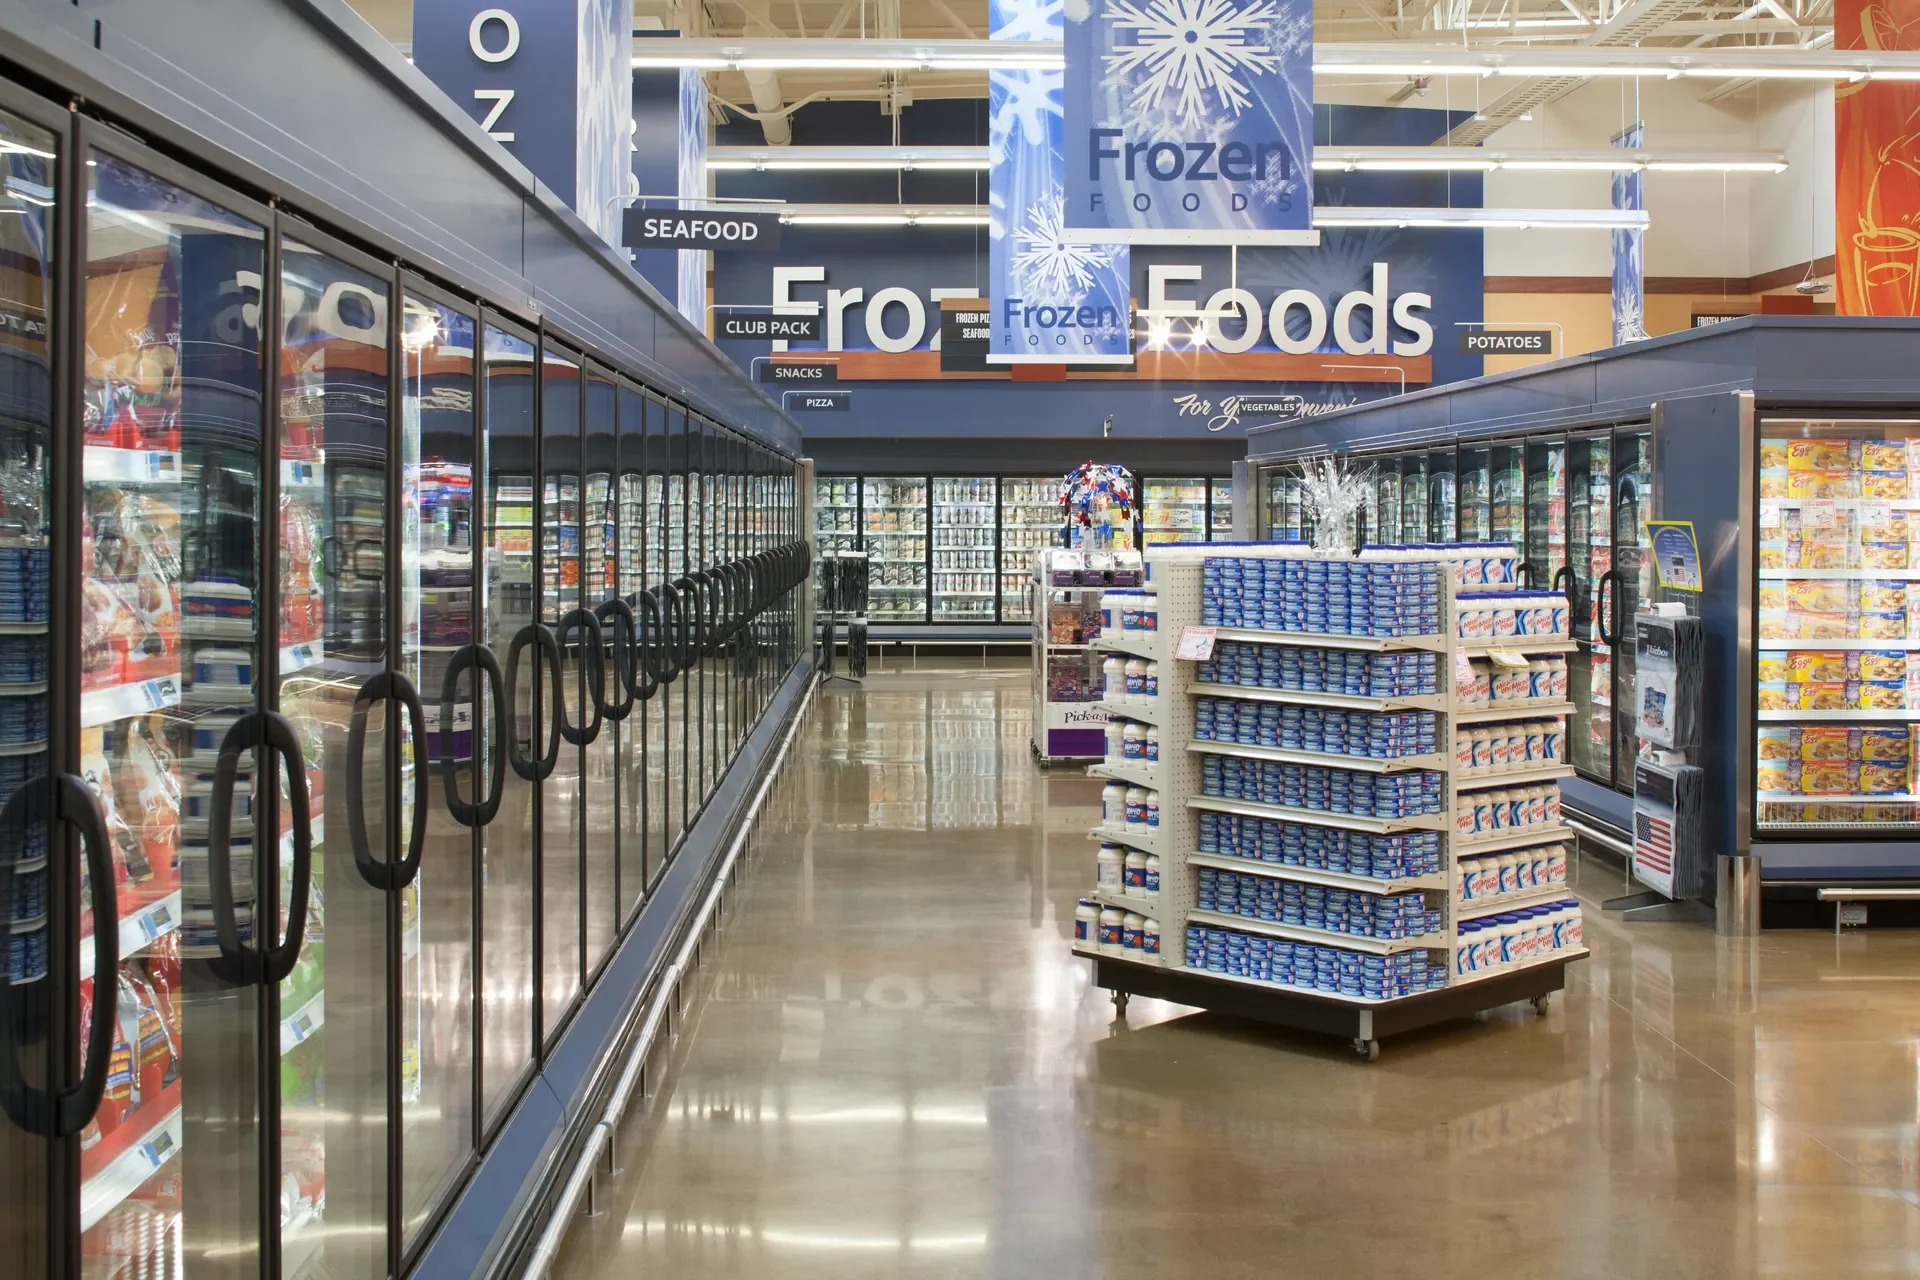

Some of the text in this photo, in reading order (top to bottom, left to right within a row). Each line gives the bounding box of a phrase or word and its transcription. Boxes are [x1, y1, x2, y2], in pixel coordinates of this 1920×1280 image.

[1089, 128, 1290, 181] Frozen
[1090, 192, 1292, 213] FOODS
[643, 217, 759, 242] SEAFOOD
[1004, 299, 1117, 329] Frozen
[1148, 262, 1433, 357] Foods
[956, 313, 978, 324] FROZEN
[726, 320, 811, 336] CLUB PACK
[1004, 334, 1119, 346] FOODS
[1467, 334, 1542, 350] POTATOES
[775, 366, 823, 379] SNACKS
[806, 398, 834, 408] PIZZA
[1173, 394, 1213, 417] For
[1241, 403, 1295, 412] VEGETABLES
[1791, 444, 1816, 457] Eggo
[1791, 474, 1815, 488] Eggo
[1789, 655, 1813, 670] Eggo
